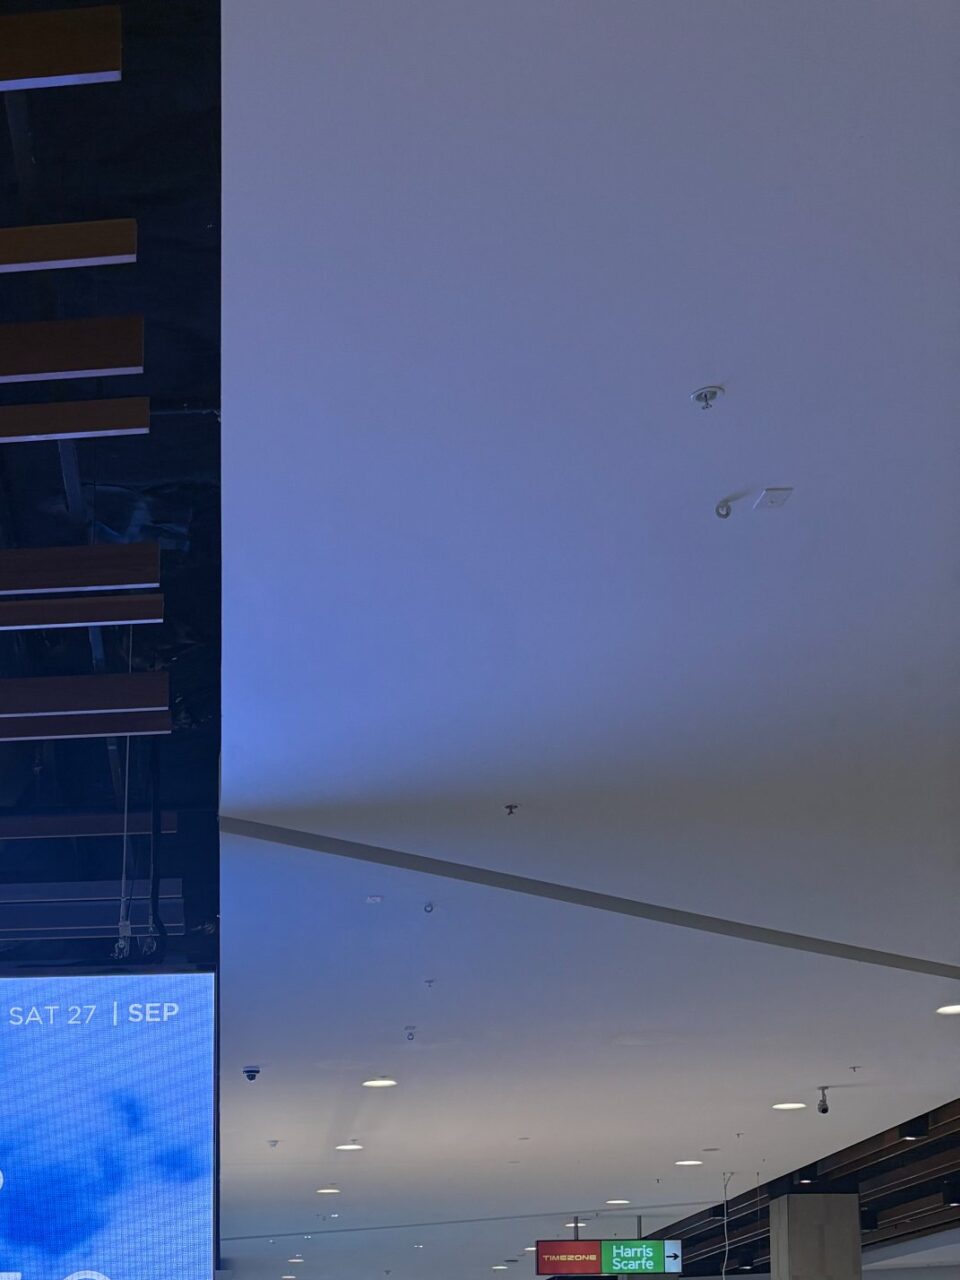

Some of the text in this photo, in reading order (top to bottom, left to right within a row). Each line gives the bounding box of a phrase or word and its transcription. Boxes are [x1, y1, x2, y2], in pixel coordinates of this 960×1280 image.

[9, 1003, 179, 1025] SAT 27 SEP
[613, 1245, 653, 1257] Harris
[612, 1258, 653, 1270] Scarfe
